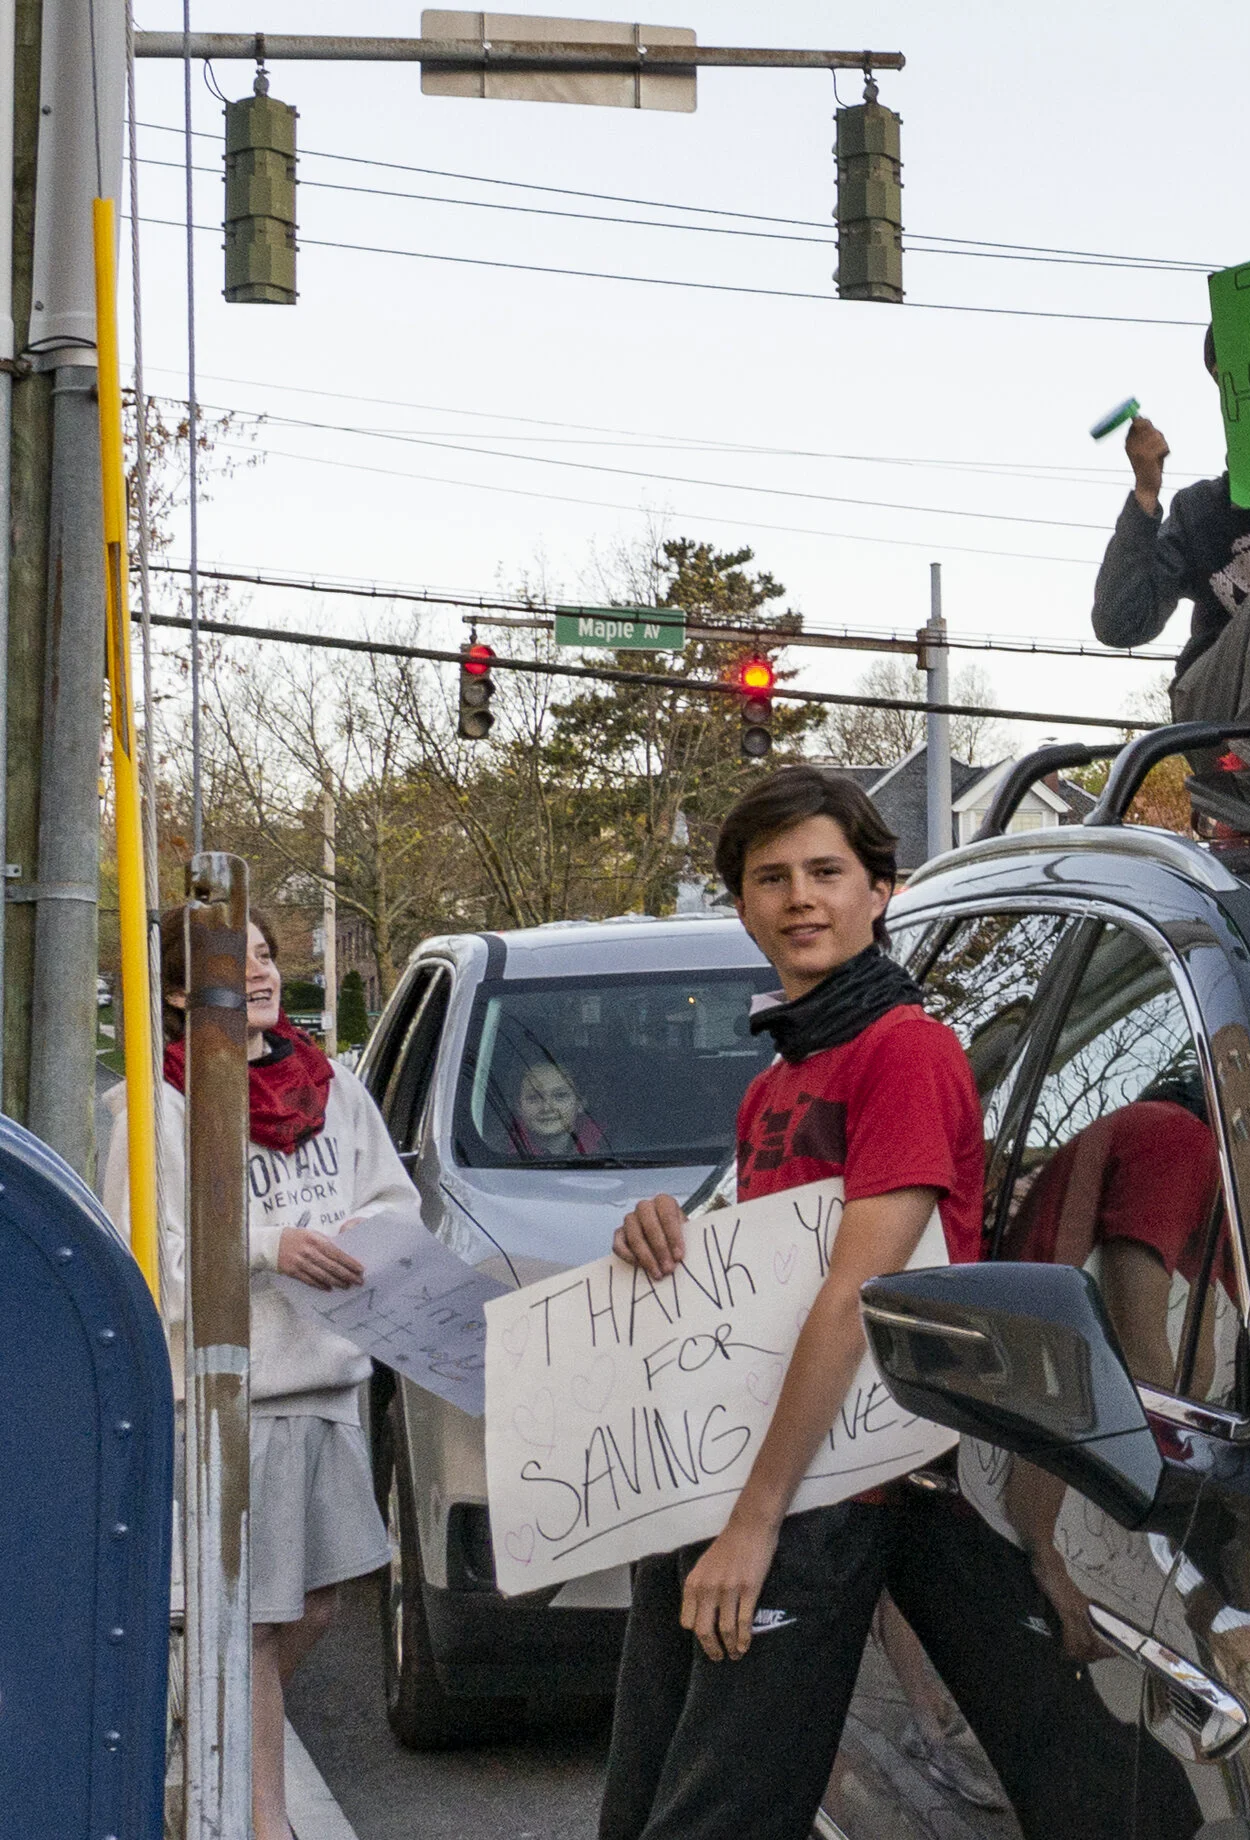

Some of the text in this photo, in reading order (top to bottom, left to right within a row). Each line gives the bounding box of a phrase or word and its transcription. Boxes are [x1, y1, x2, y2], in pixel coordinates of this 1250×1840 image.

[578, 617, 661, 642] Maple AV
[530, 1218, 756, 1366] THANK
[644, 1323, 786, 1392] FOR
[521, 1404, 751, 1542] SAVING
[753, 1608, 787, 1626] NIKE
